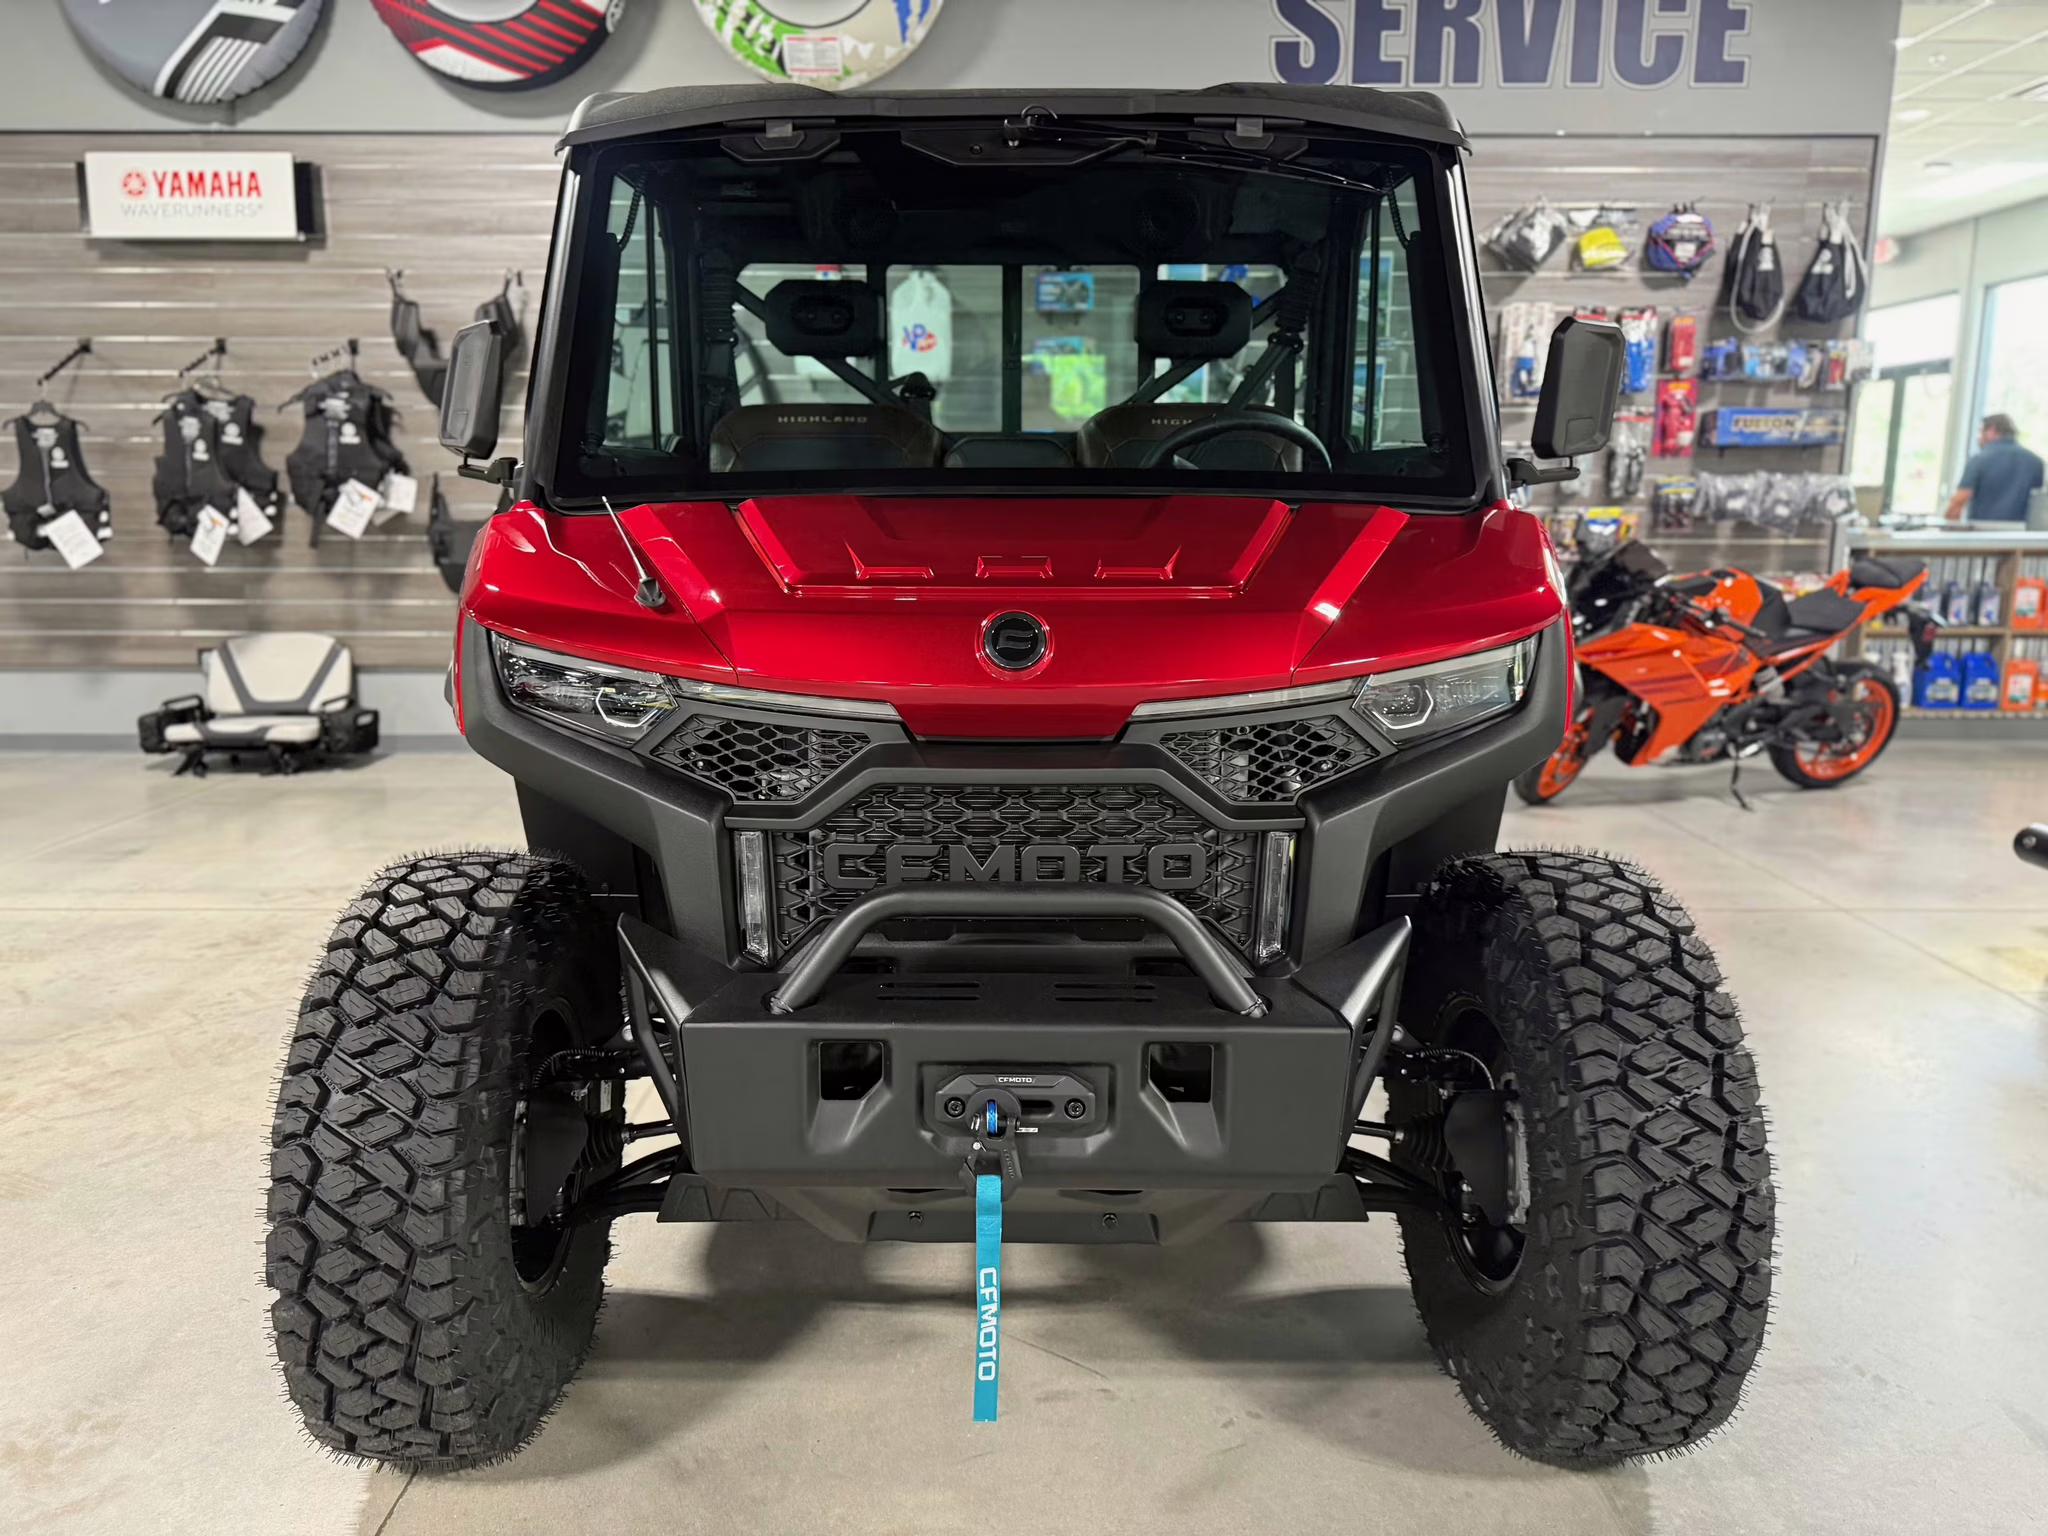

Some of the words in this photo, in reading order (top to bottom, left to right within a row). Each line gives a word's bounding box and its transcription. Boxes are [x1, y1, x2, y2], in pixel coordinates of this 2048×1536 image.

[1271, 0, 1750, 88] SERVICE
[153, 171, 262, 197] YAMAHA
[777, 415, 868, 423] HIGHLAND
[823, 842, 1208, 890] CFMOTO
[978, 1267, 998, 1381] CFMOTO
